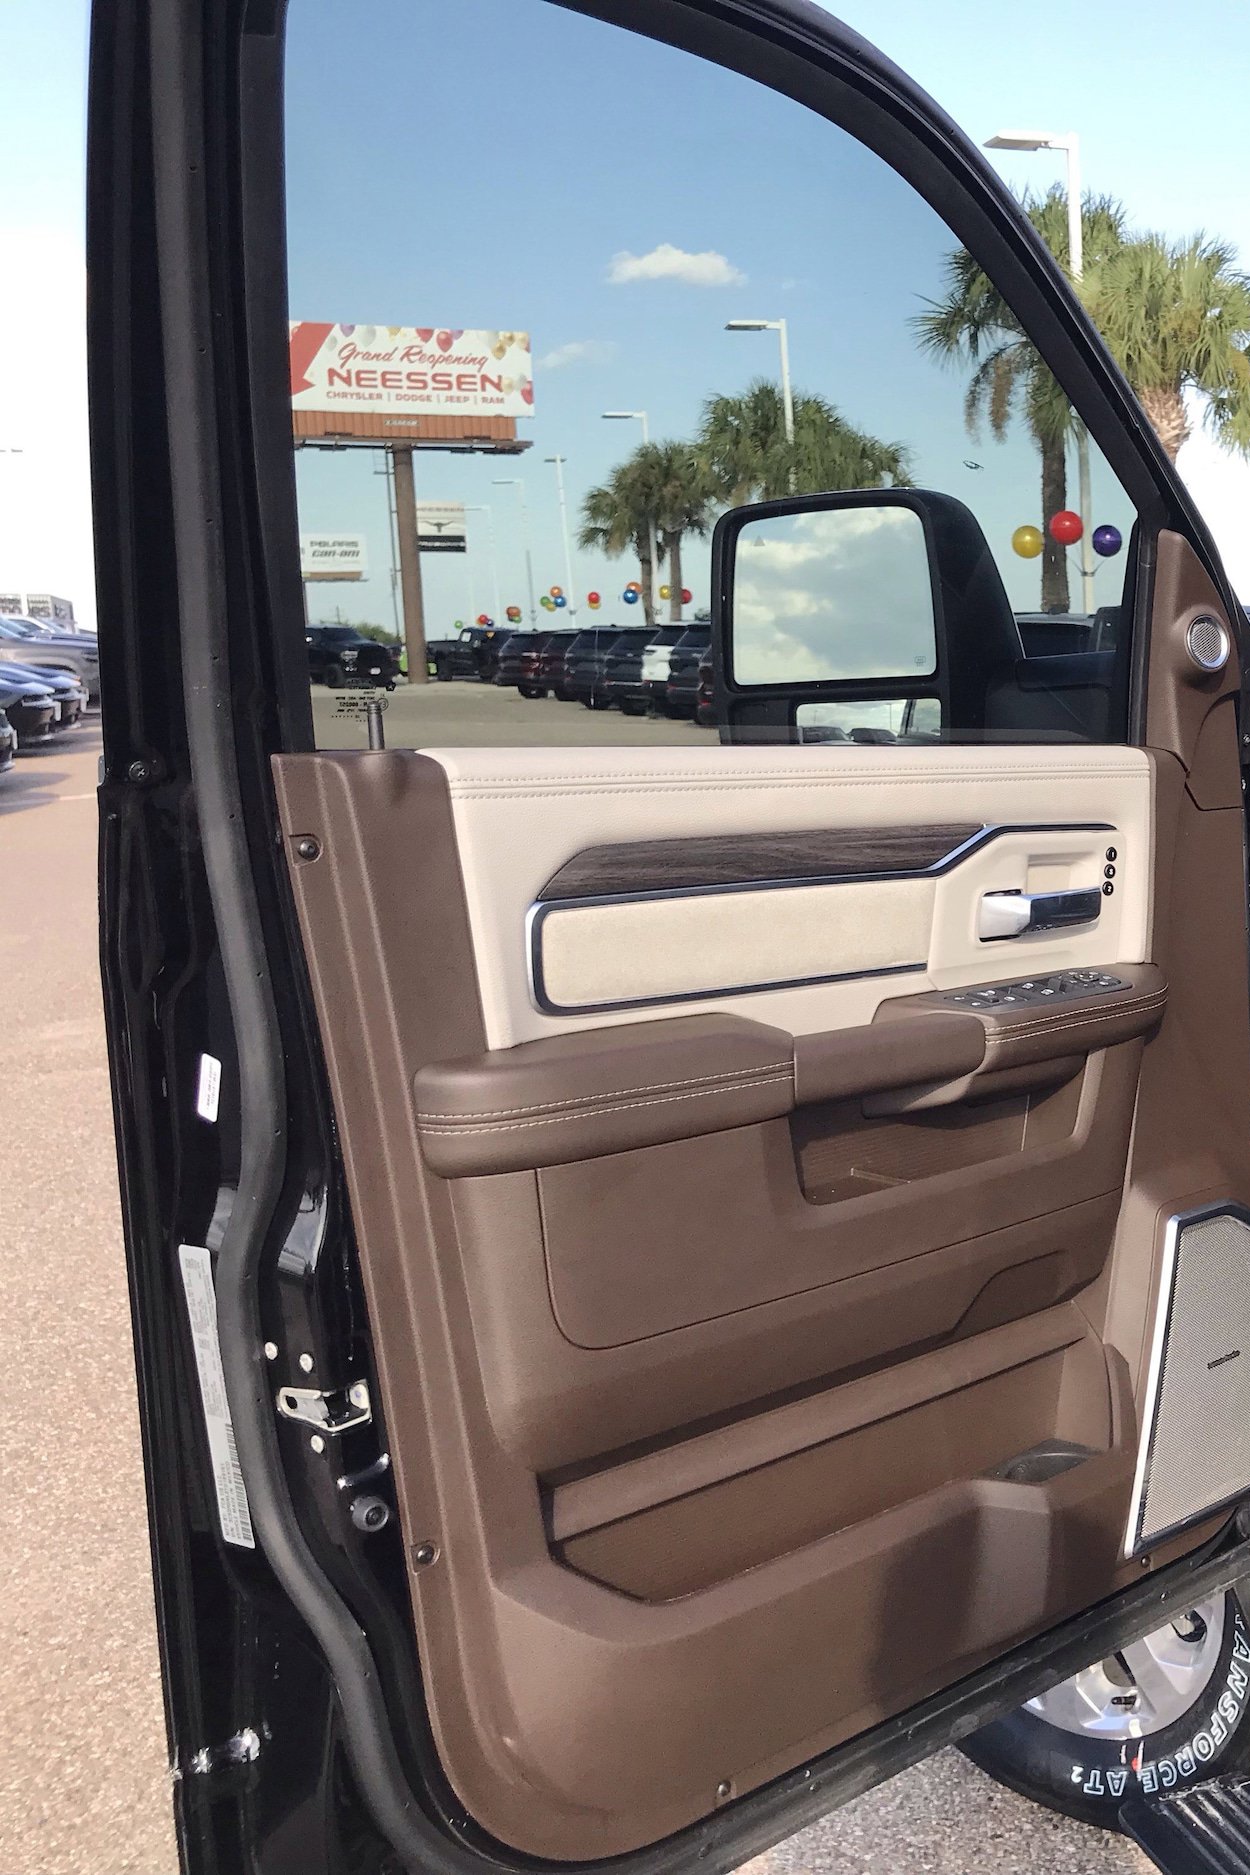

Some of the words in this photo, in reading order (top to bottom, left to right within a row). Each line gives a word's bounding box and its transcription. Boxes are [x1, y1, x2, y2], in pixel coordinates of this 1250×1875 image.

[338, 342, 398, 369] Grand
[400, 345, 488, 373] Reopening
[327, 367, 504, 392] NEESSEN
[326, 391, 383, 400] CHRYSLER
[395, 393, 433, 402] DODGE
[444, 395, 470, 403] JEEP
[481, 396, 505, 404] RAM
[310, 540, 359, 548] POLARIS
